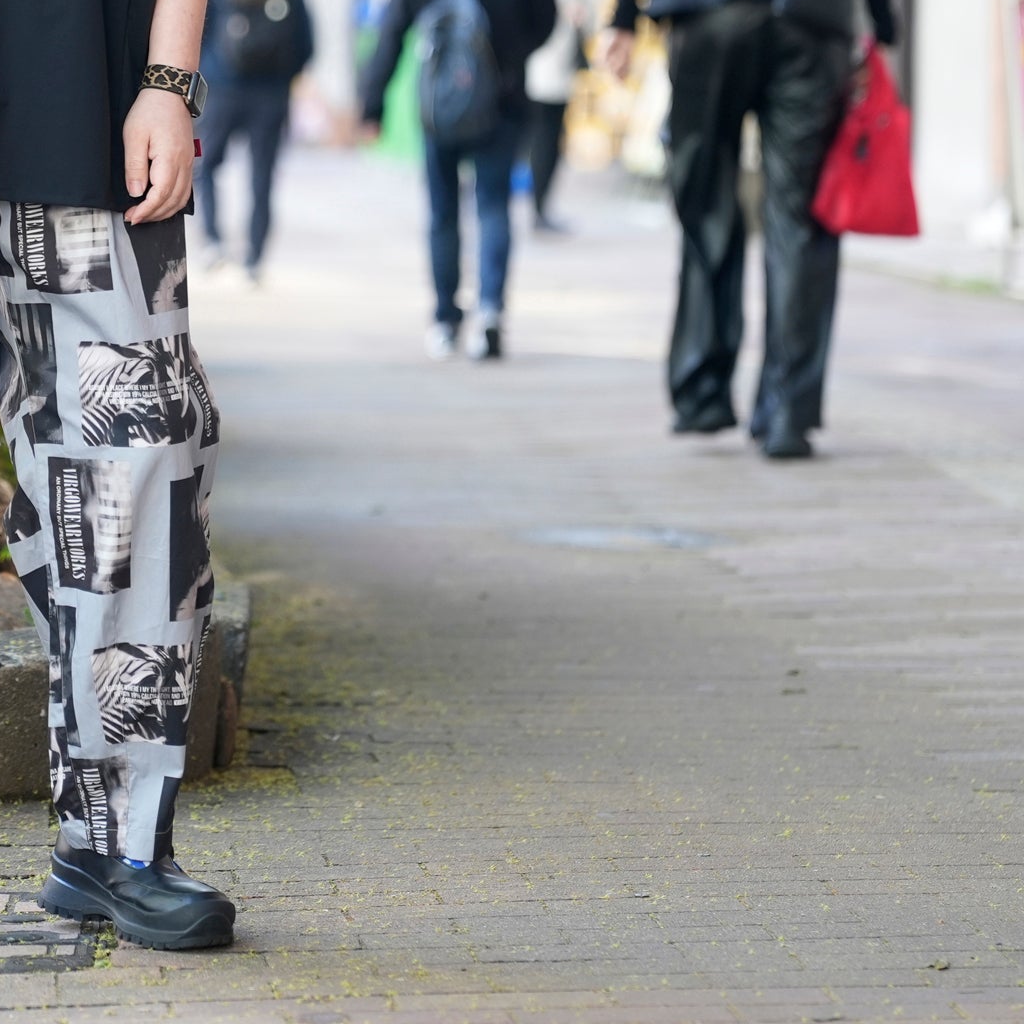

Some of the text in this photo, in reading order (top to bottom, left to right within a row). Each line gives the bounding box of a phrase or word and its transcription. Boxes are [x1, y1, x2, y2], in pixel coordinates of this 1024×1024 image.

[55, 476, 61, 485] AN
[58, 527, 66, 549] SPECIAL
[62, 468, 87, 581] VIRGOWEARWORKS
